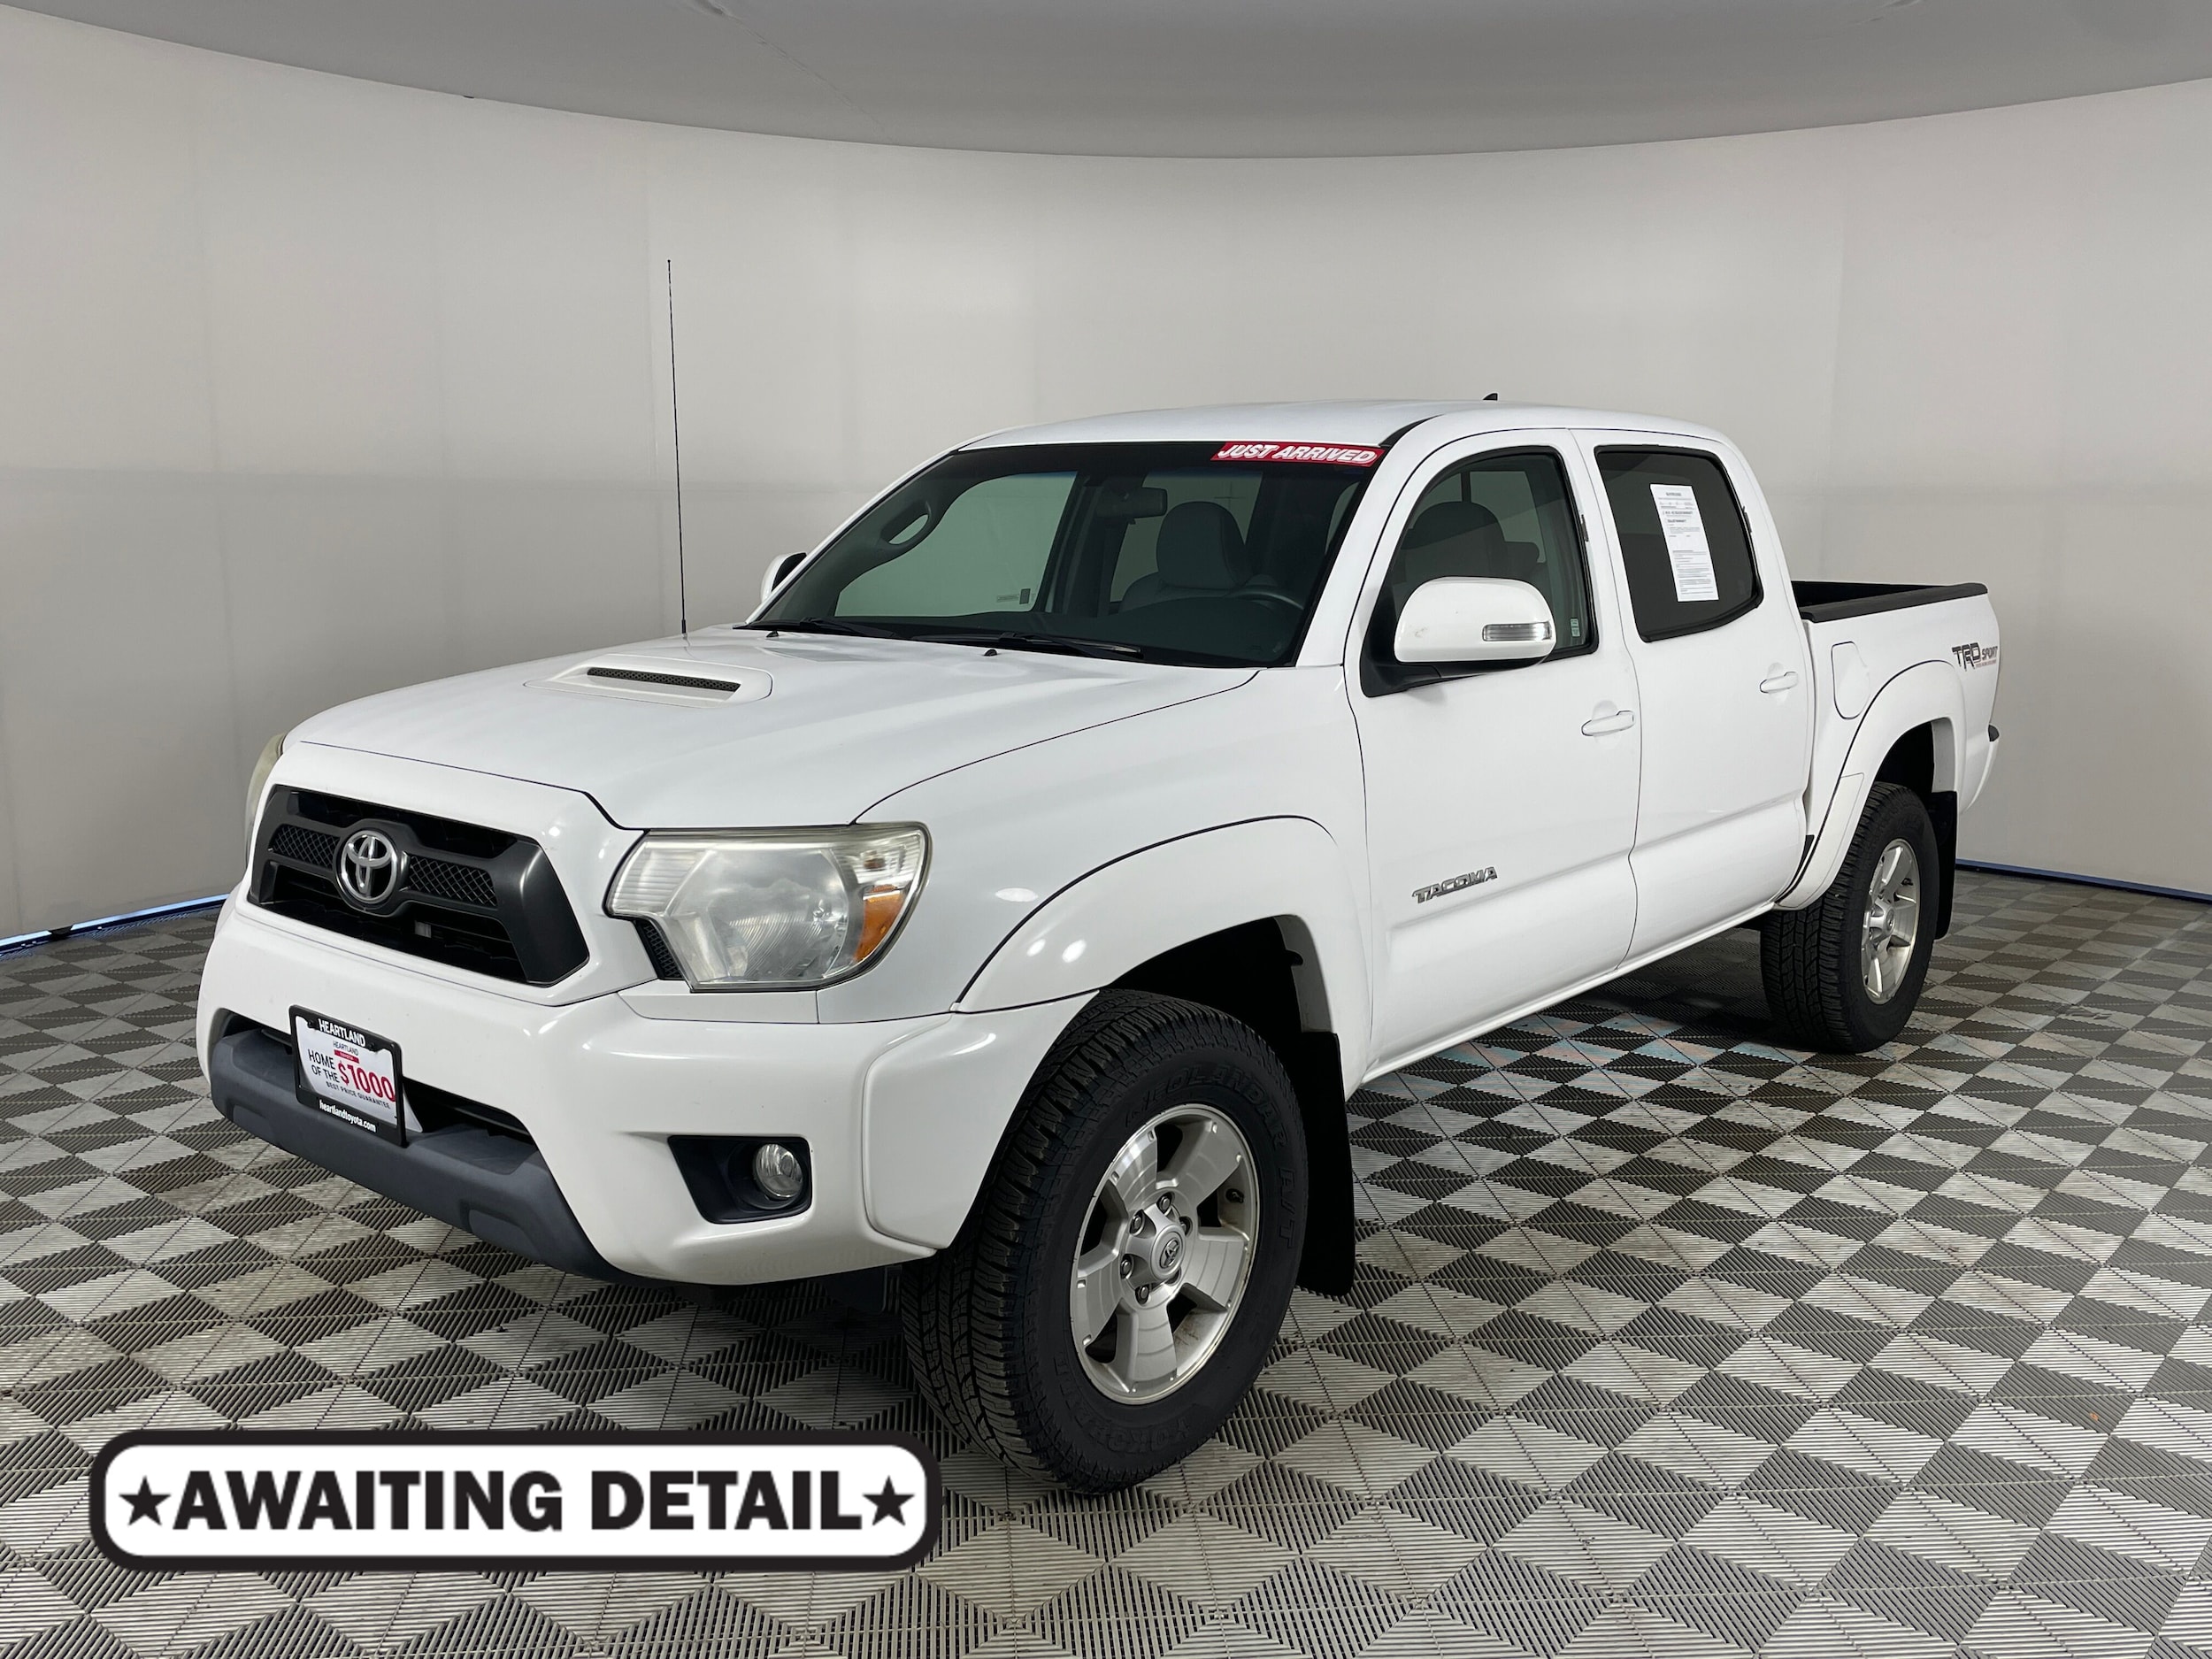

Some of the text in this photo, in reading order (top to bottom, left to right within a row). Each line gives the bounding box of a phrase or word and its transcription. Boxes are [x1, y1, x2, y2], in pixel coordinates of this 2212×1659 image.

[1217, 444, 1378, 464] JUST ARRIVED
[1952, 642, 1981, 672] TRD
[1412, 866, 1497, 903] TACOMA
[319, 1018, 365, 1047] HEARTLAND
[307, 1048, 336, 1070] HOME
[333, 1041, 358, 1056] HEARTLAND
[311, 1064, 340, 1083] OF THE
[337, 1061, 396, 1102] $1000
[319, 1099, 376, 1133] heartlandtoyota.com
